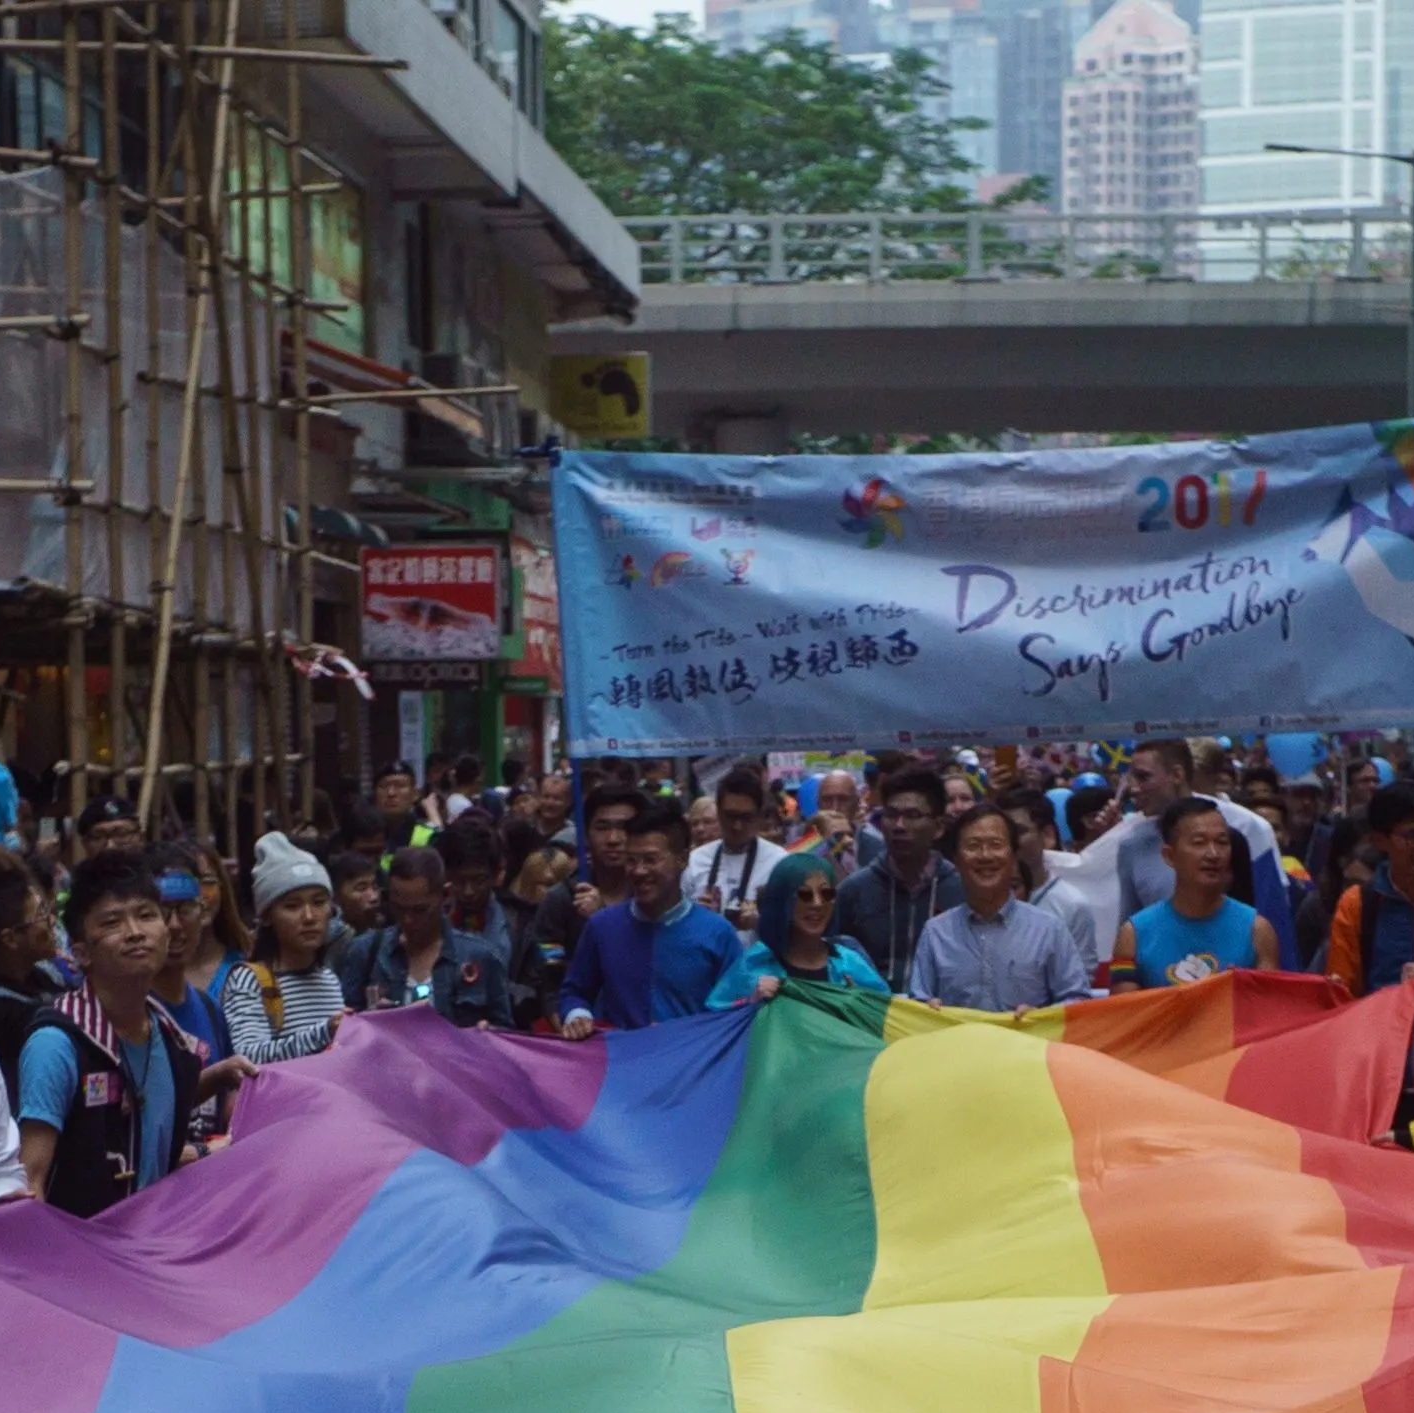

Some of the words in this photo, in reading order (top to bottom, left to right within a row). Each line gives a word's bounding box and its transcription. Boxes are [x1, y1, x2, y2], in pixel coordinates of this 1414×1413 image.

[1136, 469, 1267, 533] 2017
[940, 552, 1273, 633] Discrimination
[1017, 632, 1125, 701] Says
[1141, 581, 1304, 662] Goodbye
